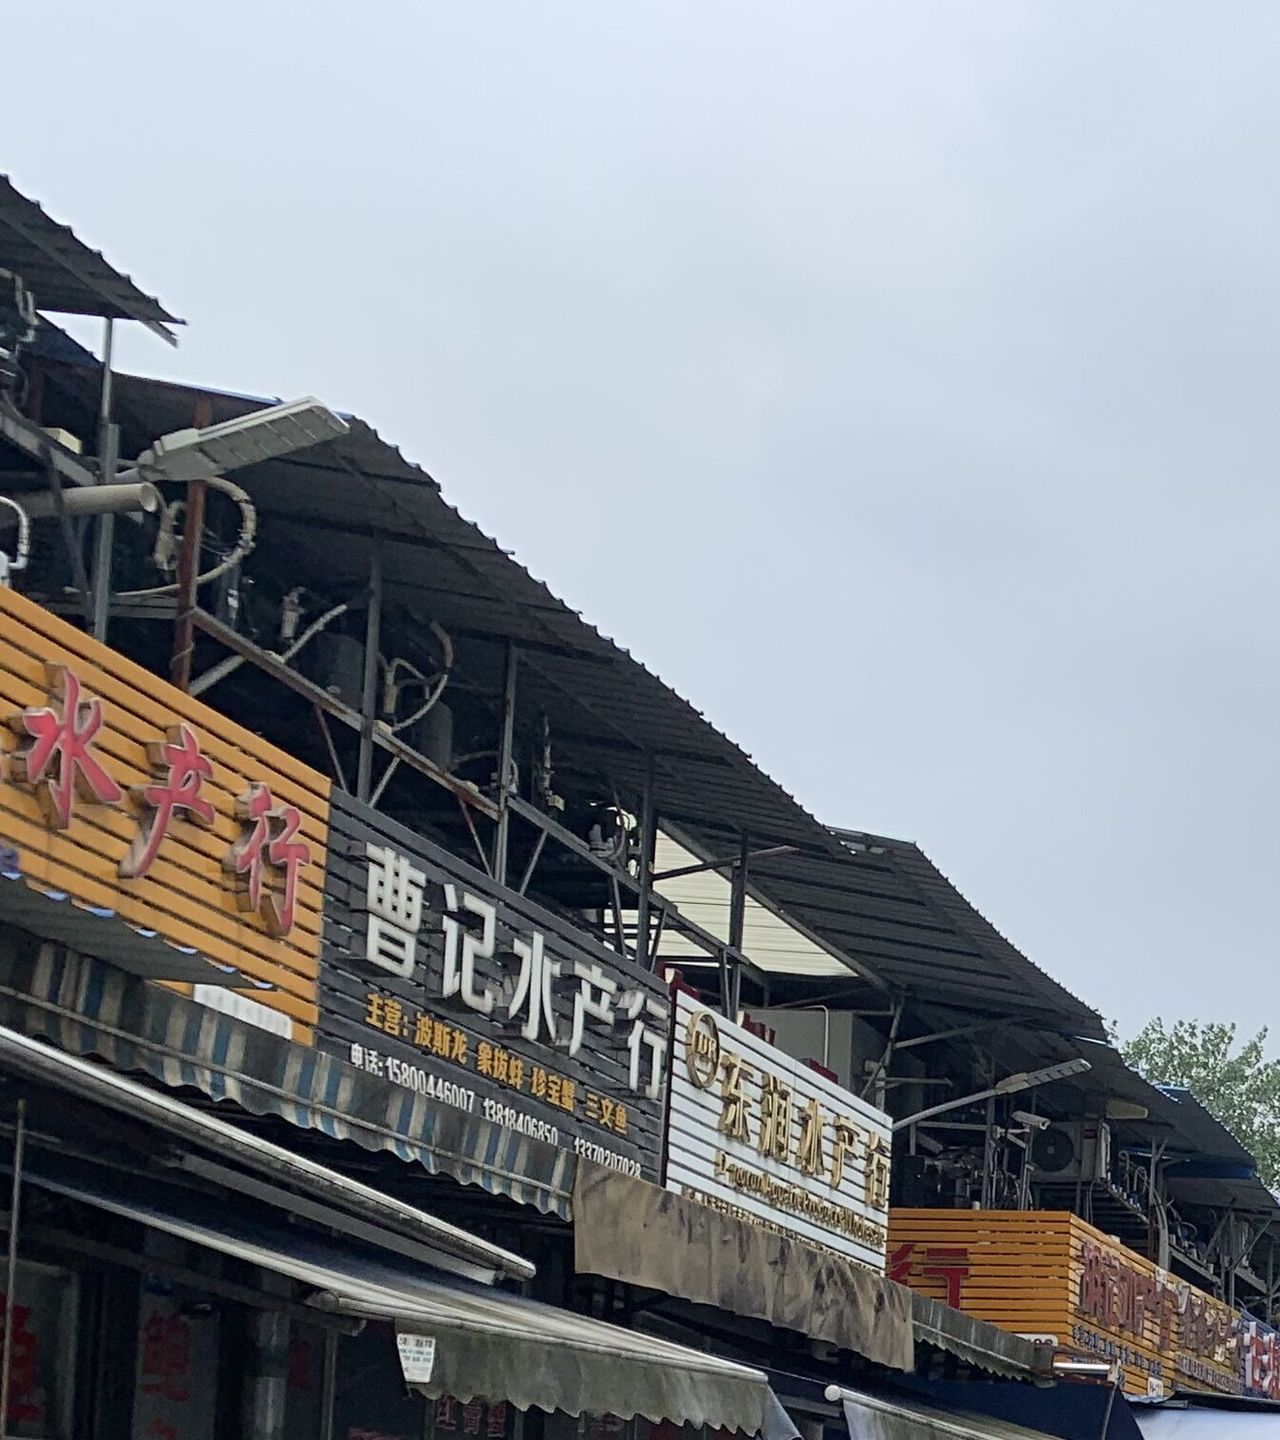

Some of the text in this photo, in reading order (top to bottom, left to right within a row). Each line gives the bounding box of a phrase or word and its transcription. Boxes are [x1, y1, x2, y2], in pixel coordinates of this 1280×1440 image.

[366, 842, 668, 1099] 曹记水产行
[584, 1092, 629, 1136] 三文鱼
